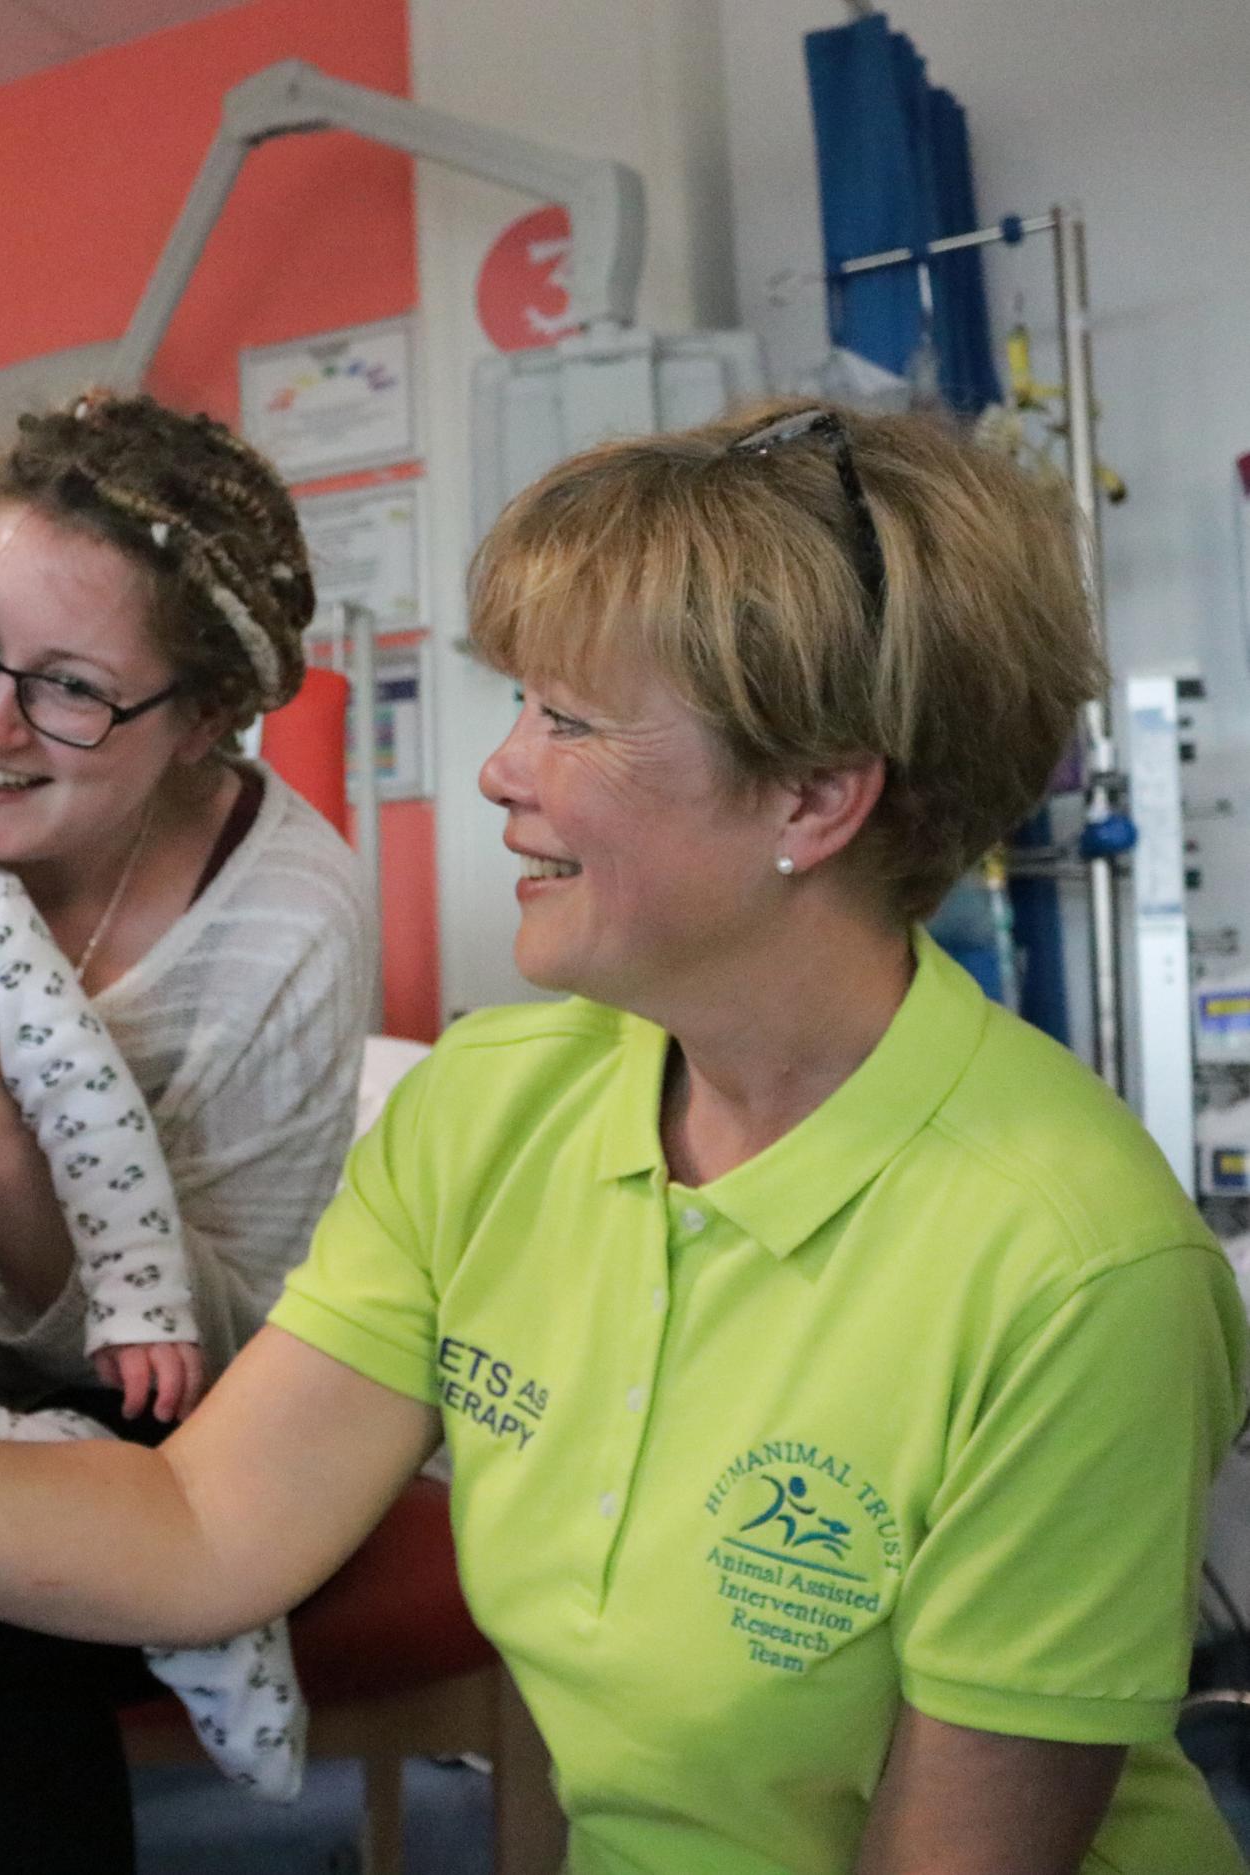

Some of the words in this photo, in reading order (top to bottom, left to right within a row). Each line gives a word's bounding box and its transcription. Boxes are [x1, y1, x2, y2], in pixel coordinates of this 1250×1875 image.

[526, 239, 580, 334] 3
[438, 1336, 513, 1398] ETS
[518, 1379, 549, 1411] AS
[438, 1376, 536, 1451] ERAPY
[704, 1442, 852, 1516] HUMANIMAL
[856, 1482, 902, 1577] TRUST
[706, 1546, 784, 1586] Animal
[787, 1572, 880, 1613] Assisted
[718, 1575, 853, 1633] Intervention
[730, 1606, 830, 1653] Research
[747, 1638, 804, 1673] Team
